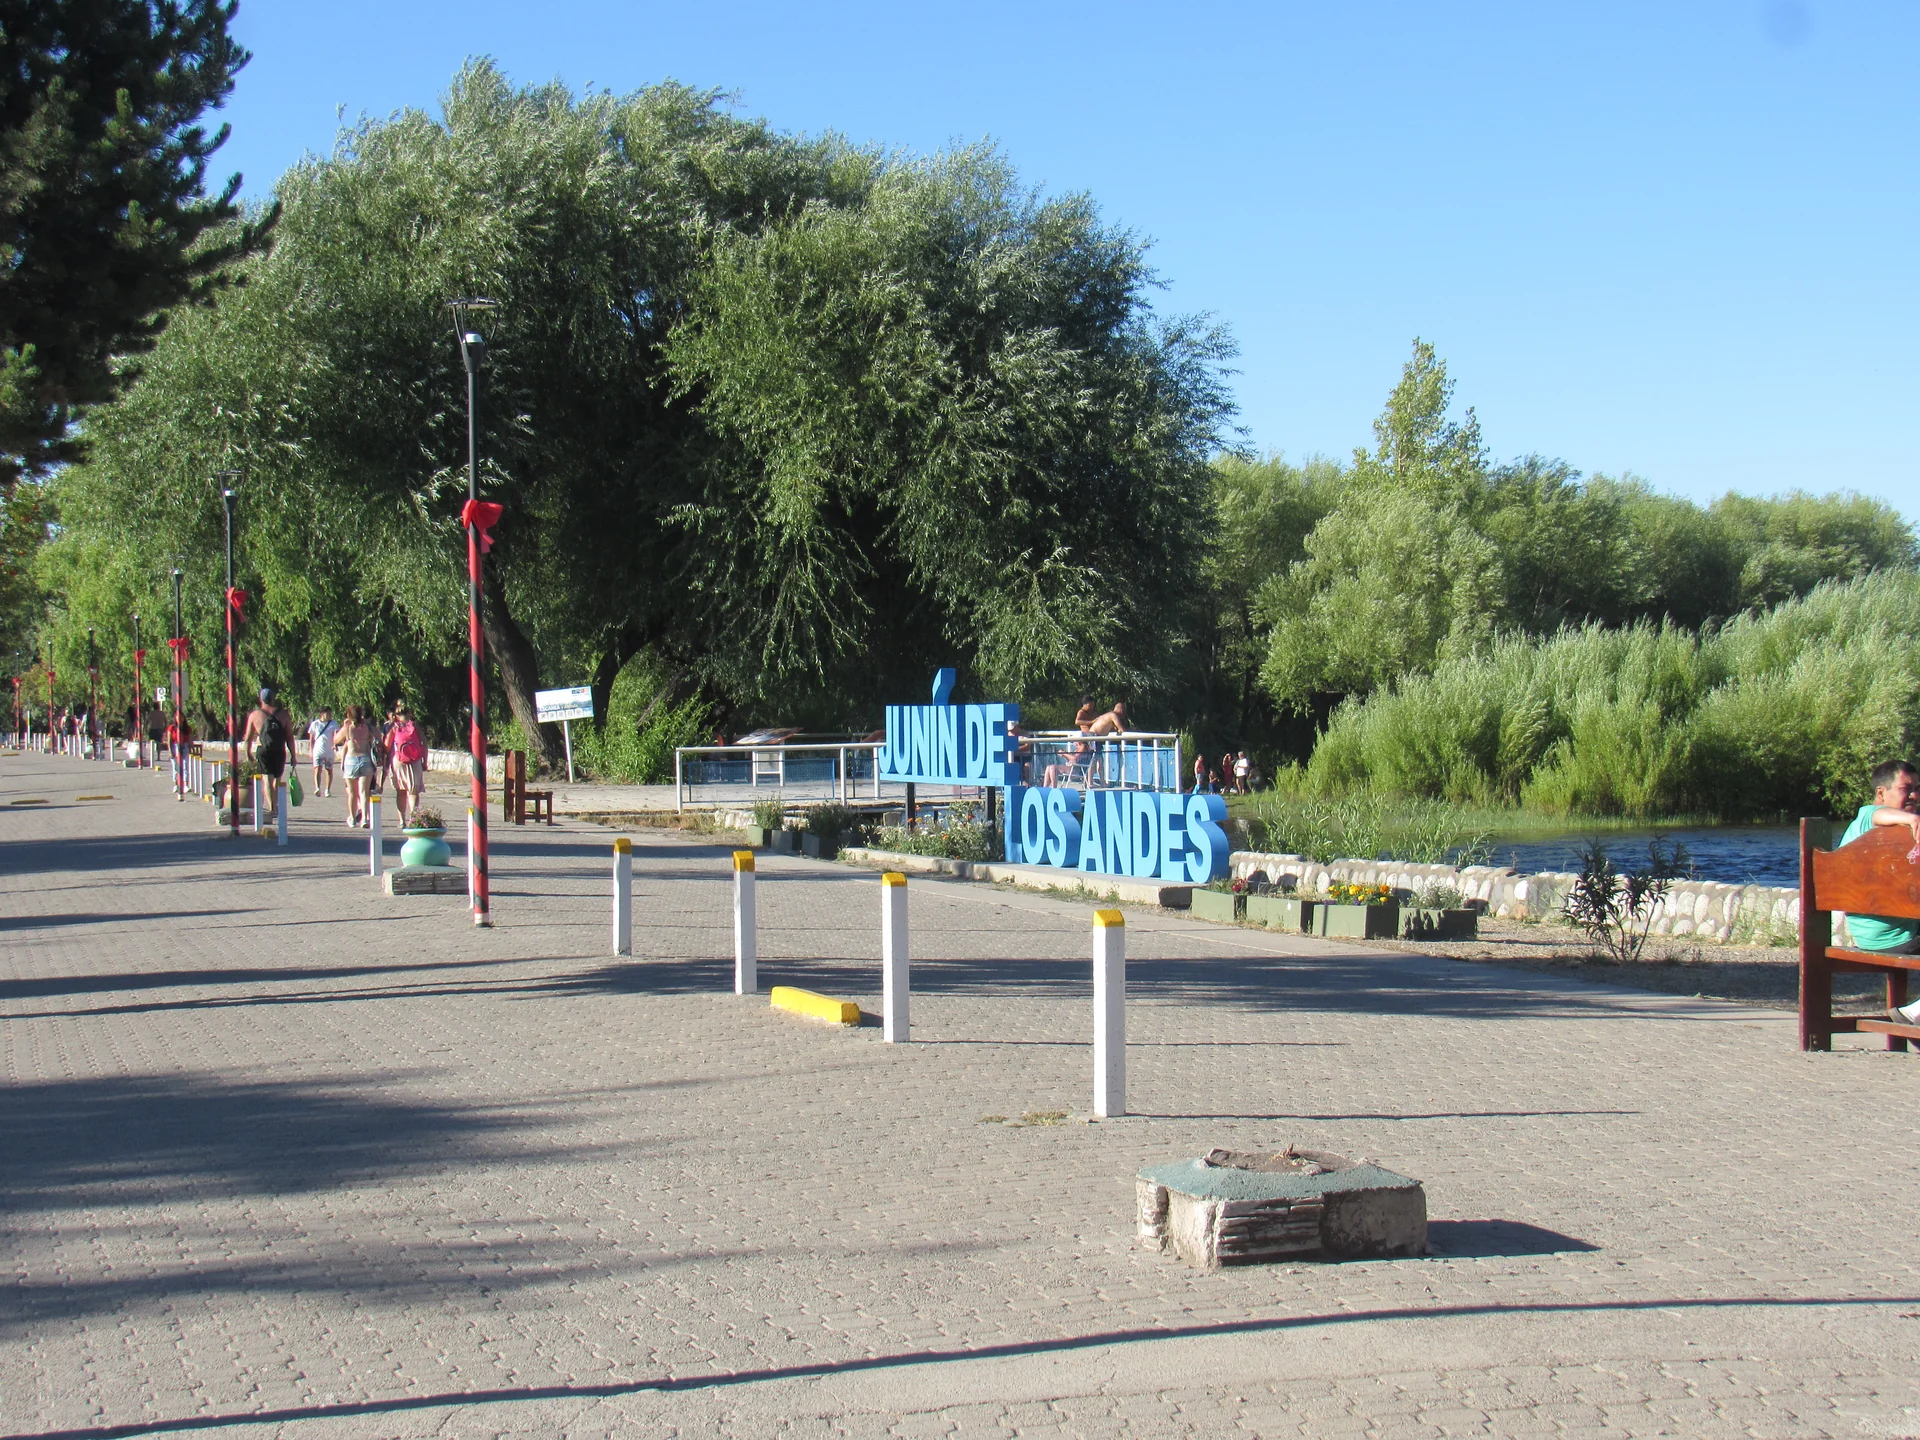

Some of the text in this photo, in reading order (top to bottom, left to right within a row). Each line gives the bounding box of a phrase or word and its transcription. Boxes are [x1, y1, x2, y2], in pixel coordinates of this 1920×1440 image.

[879, 667, 1013, 782] JUNÍN DE
[1004, 785, 1228, 884] LOS ANDES
